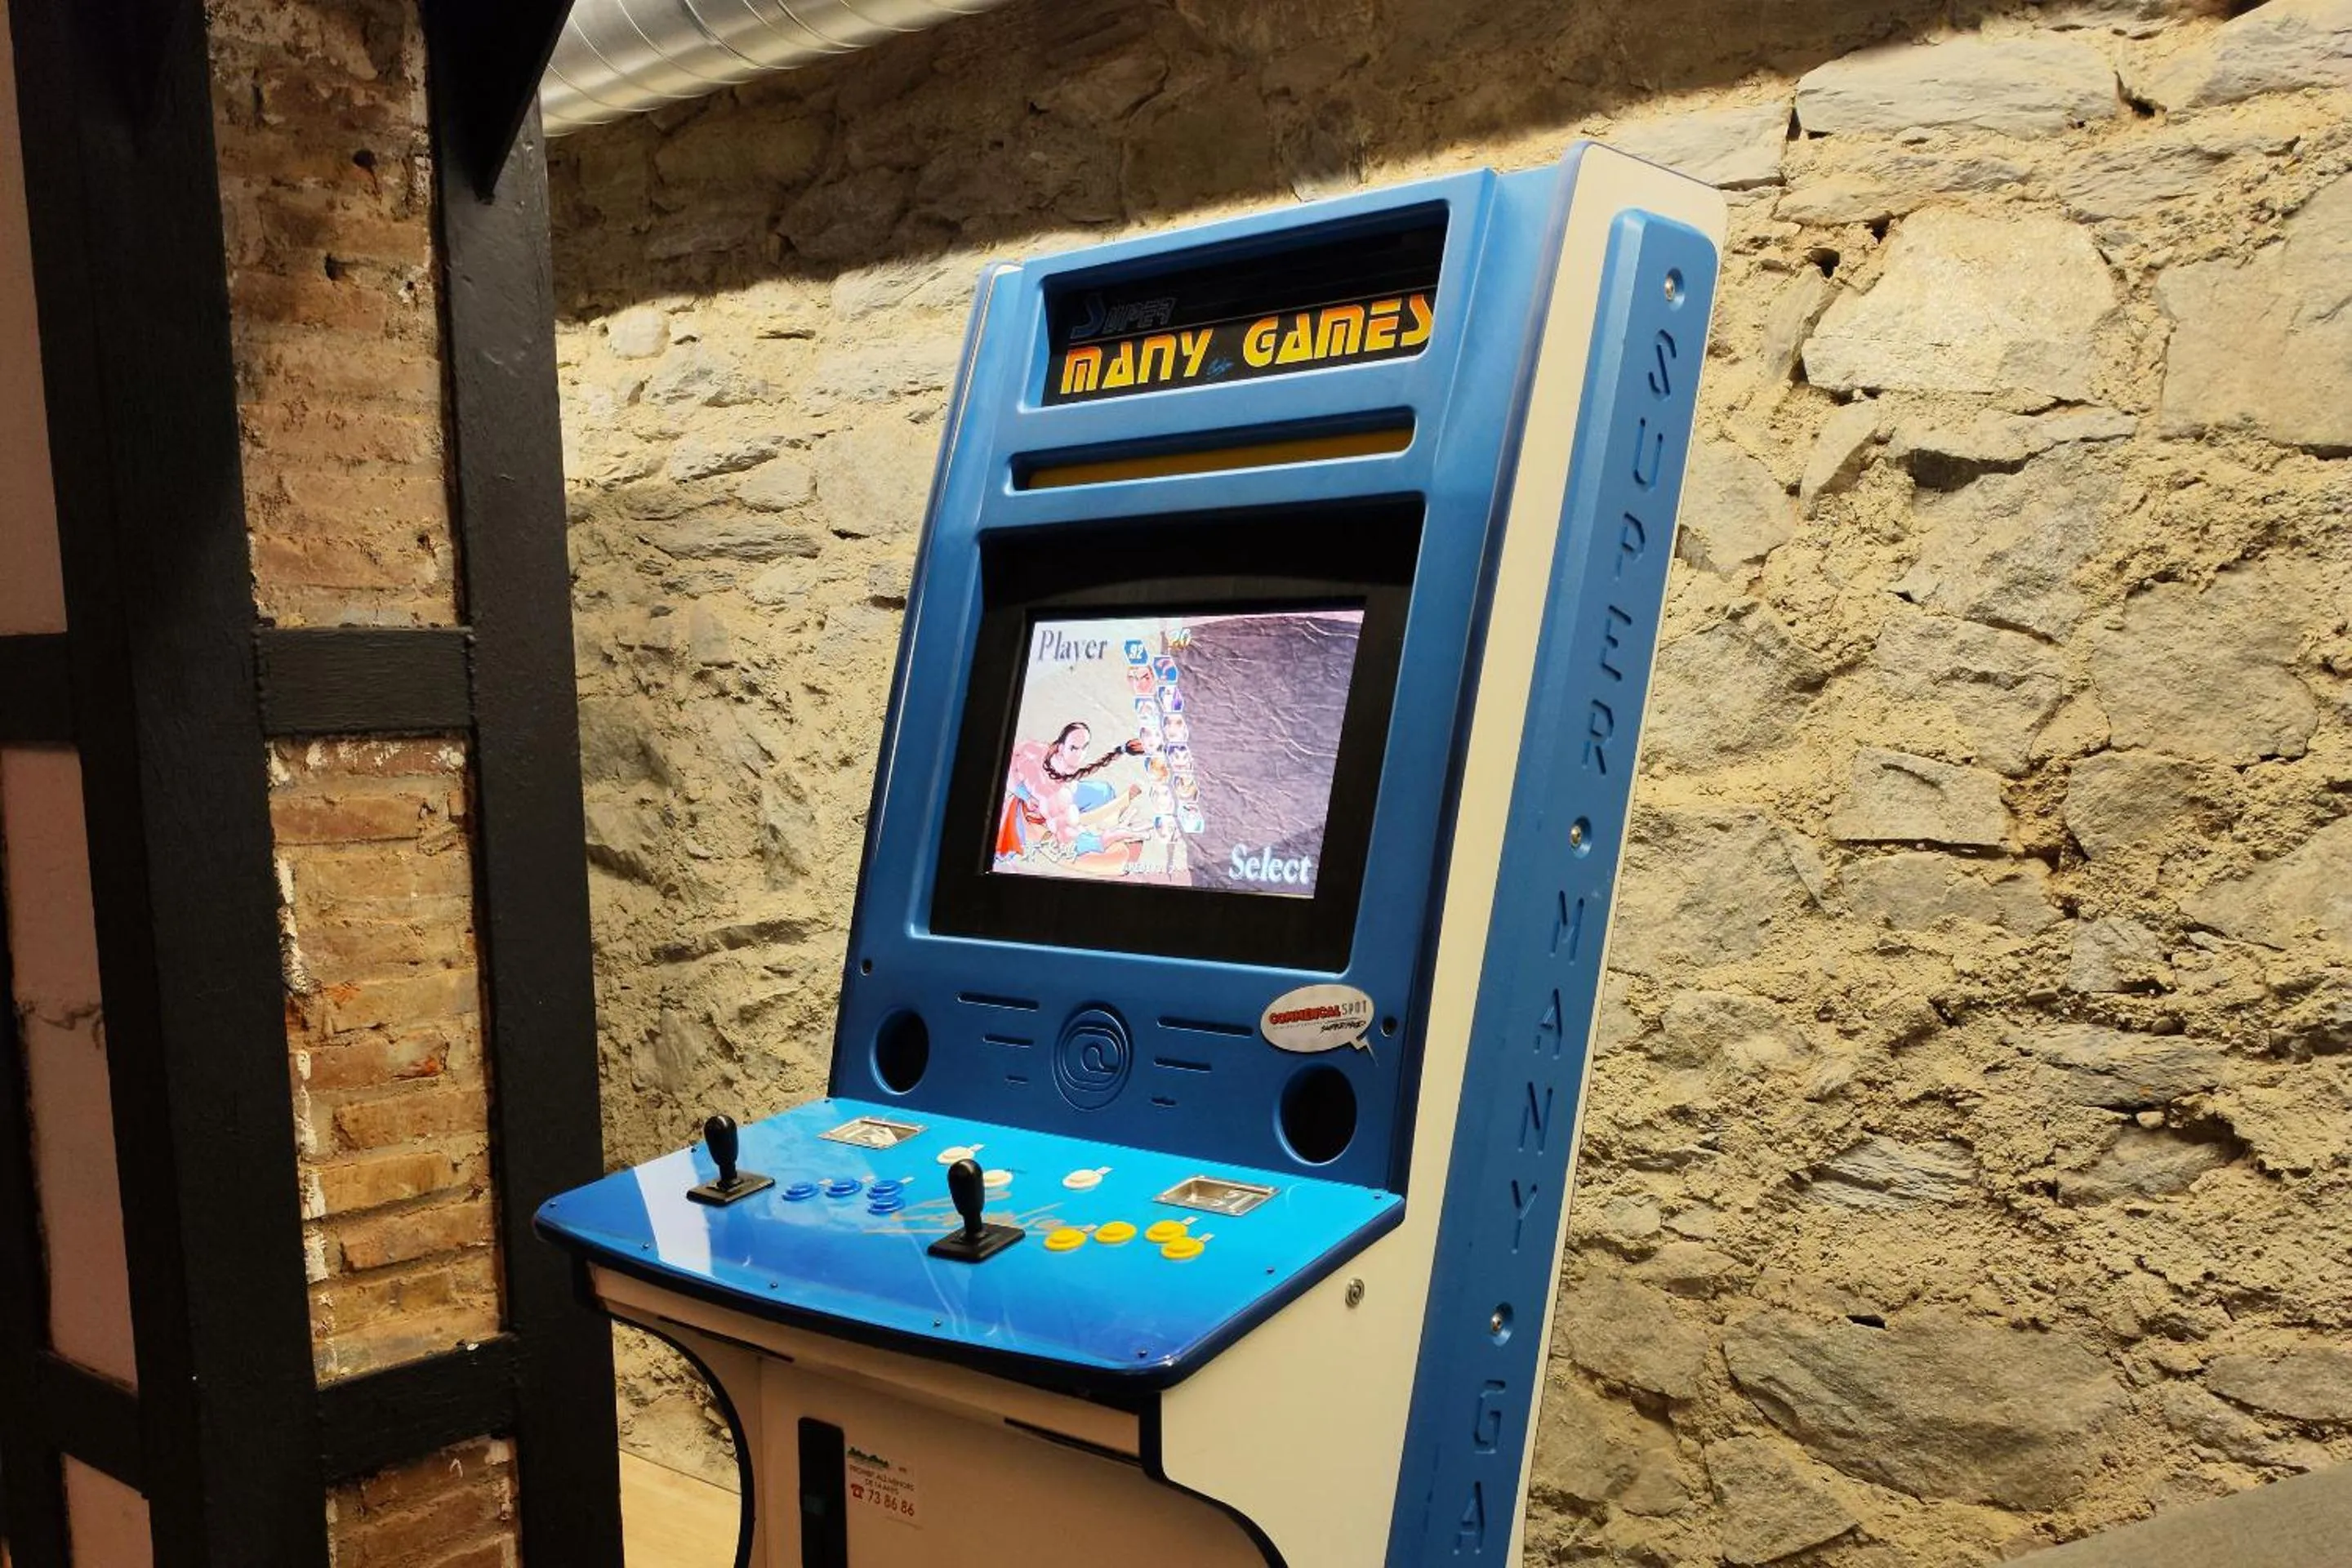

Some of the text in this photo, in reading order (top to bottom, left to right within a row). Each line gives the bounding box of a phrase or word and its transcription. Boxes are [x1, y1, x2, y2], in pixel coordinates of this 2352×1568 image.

[1060, 294, 1435, 394] MANY GAMES
[1581, 328, 1677, 776] SUPER
[1037, 629, 1107, 662] Player
[1227, 842, 1312, 885] Select
[1509, 889, 1586, 1255] MANY
[868, 1489, 915, 1517] 73 86 86
